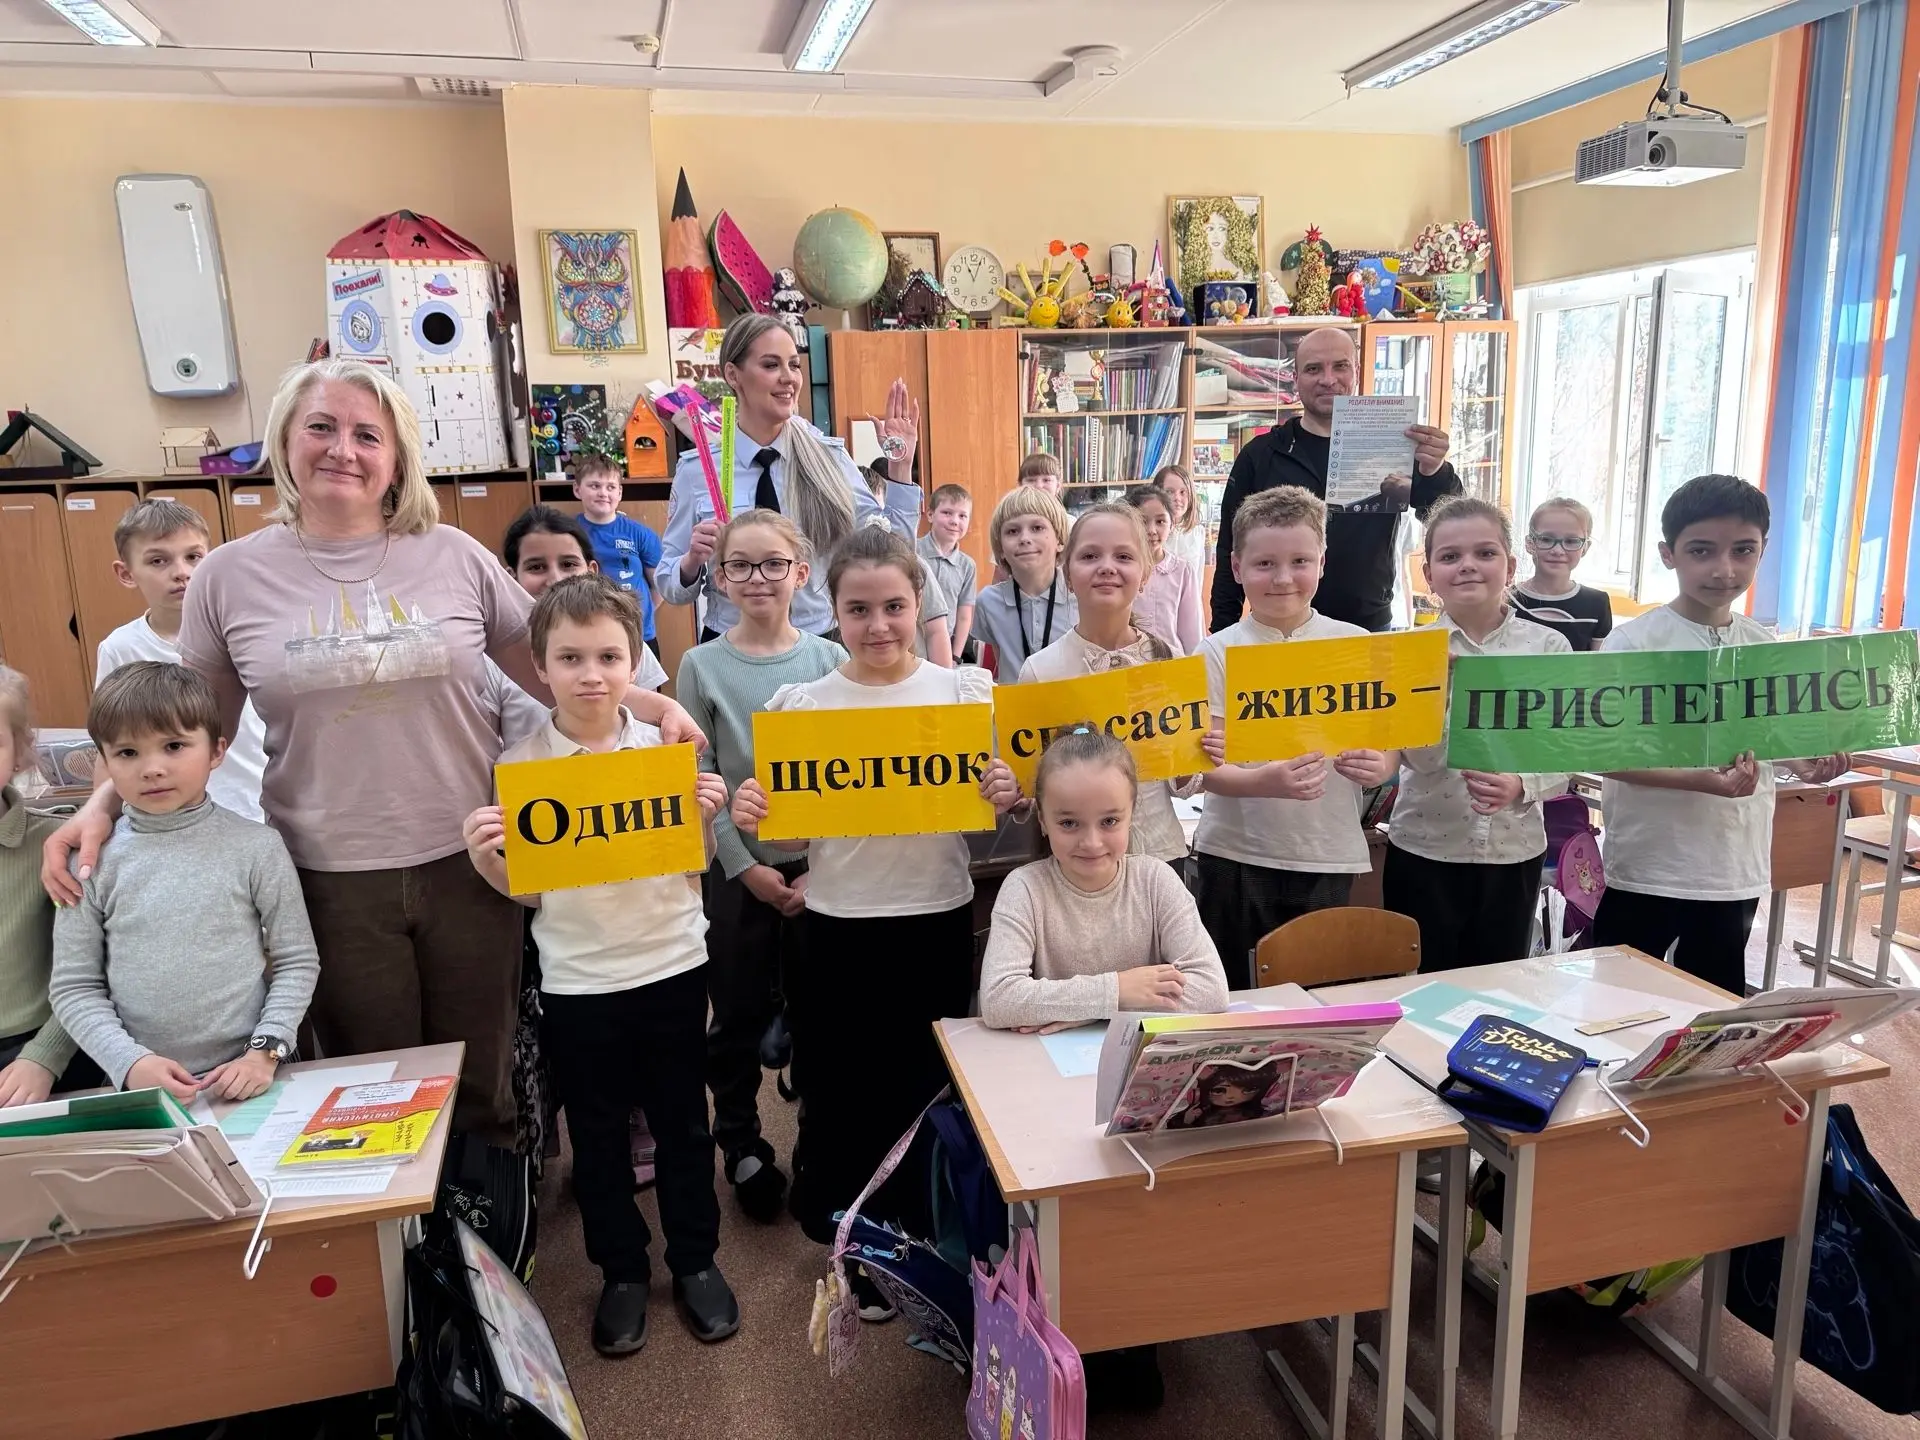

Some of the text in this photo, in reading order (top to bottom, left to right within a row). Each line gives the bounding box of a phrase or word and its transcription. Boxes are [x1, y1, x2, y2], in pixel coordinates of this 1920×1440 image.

[960, 256, 967, 264] 11
[970, 253, 979, 262] 12
[952, 265, 962, 273] 10
[988, 264, 995, 273] 2
[334, 272, 380, 295] Поехали!
[950, 276, 957, 285] 9
[991, 276, 998, 285] 3
[953, 287, 960, 296] 8
[988, 287, 995, 296] 4
[961, 295, 968, 305] 7
[970, 298, 978, 307] 6
[980, 295, 988, 304] 5
[676, 360, 720, 381] Бук
[1237, 680, 1398, 721] жизнь
[1010, 699, 1209, 758] спсает
[768, 751, 990, 797] щелчок
[517, 795, 686, 848] Один
[1480, 1025, 1559, 1062] Drive
[1499, 1025, 1574, 1059] Turbo
[1148, 1045, 1244, 1065] АЛЬБОМ
[453, 1190, 471, 1211] let's
